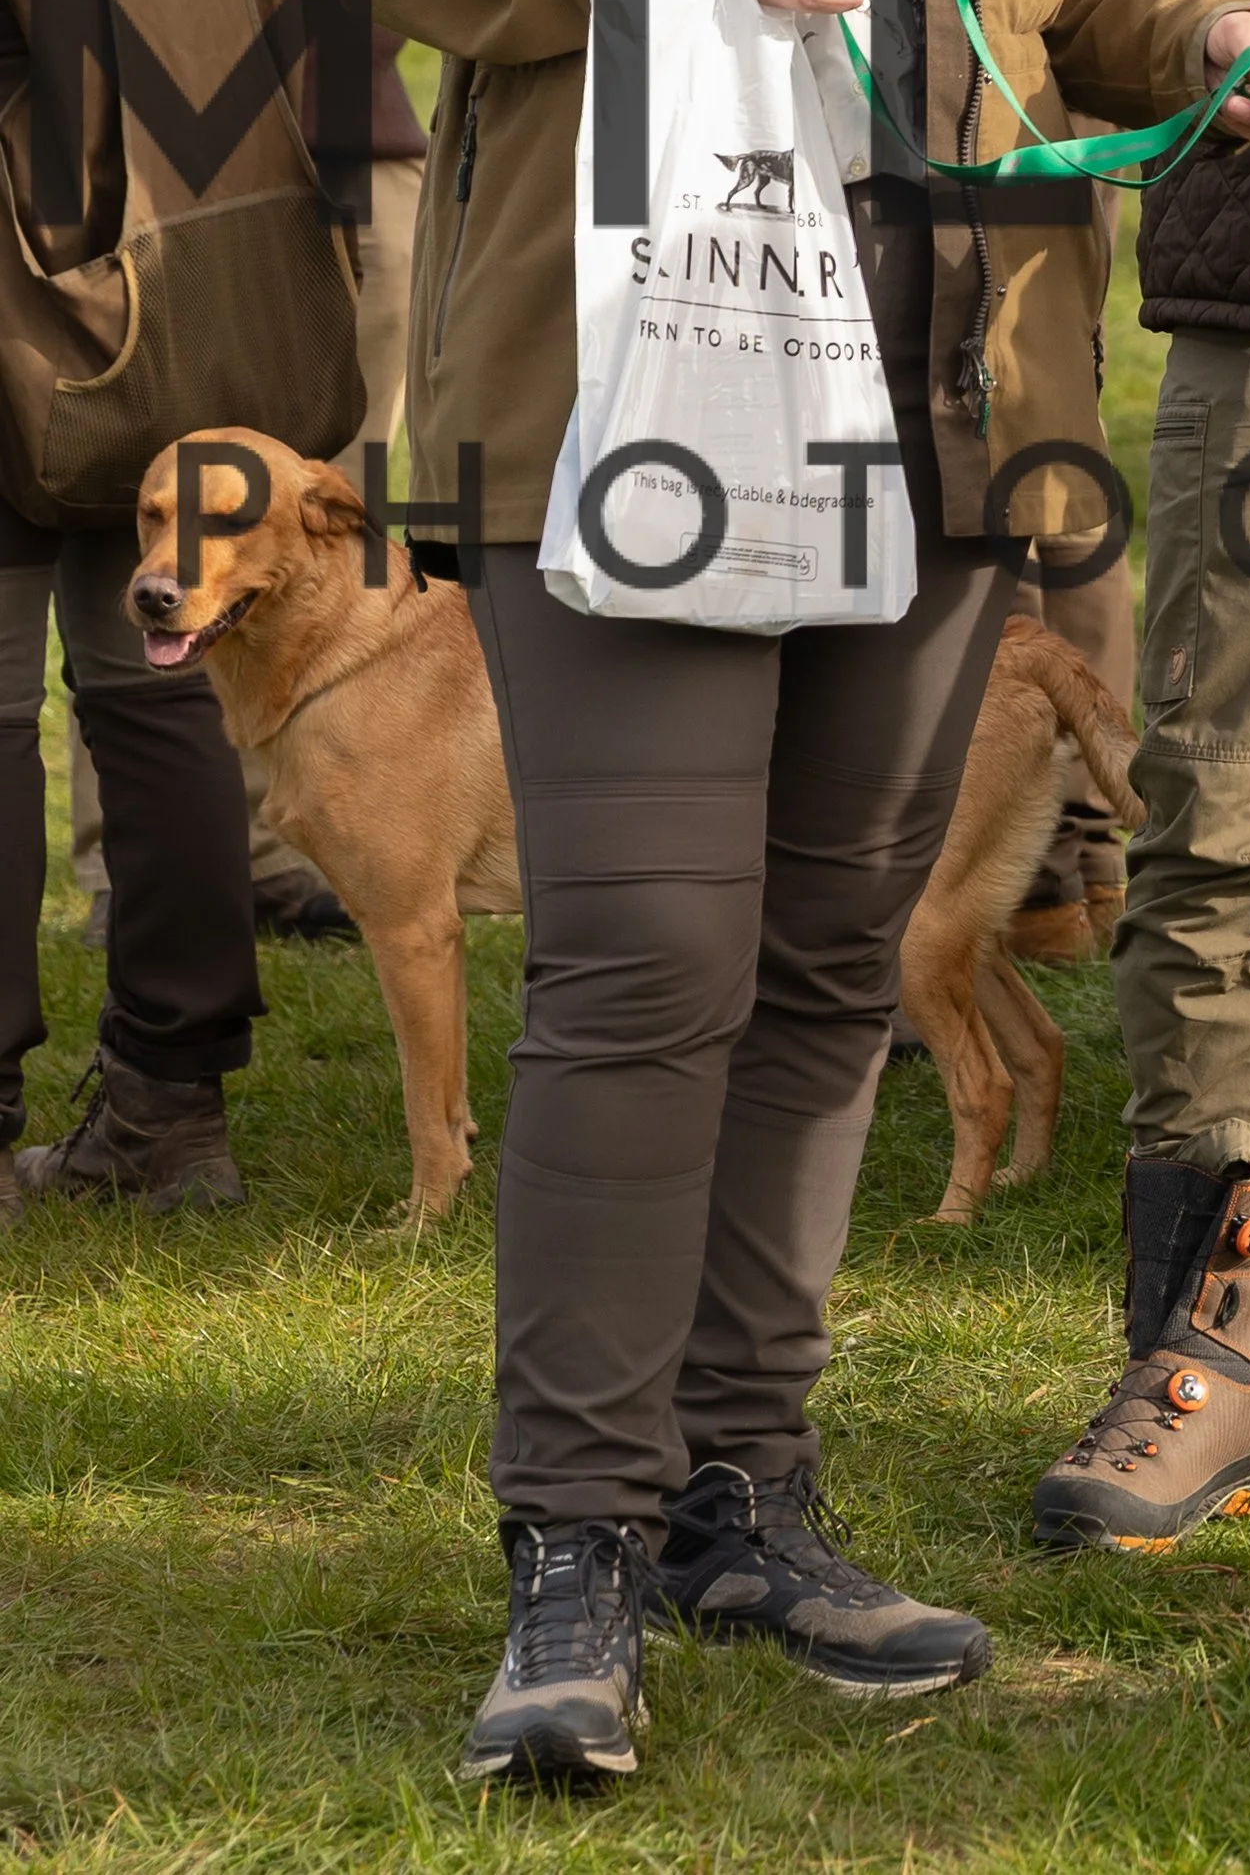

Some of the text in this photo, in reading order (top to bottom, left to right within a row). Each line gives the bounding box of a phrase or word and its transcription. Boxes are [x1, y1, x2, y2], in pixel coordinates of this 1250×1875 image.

[694, 327, 722, 347] TO
[739, 334, 764, 353] BE
[633, 471, 657, 491] This
[661, 478, 682, 497] bag
[686, 479, 697, 495] is
[699, 483, 773, 504] recyclable
[776, 489, 786, 505] &
